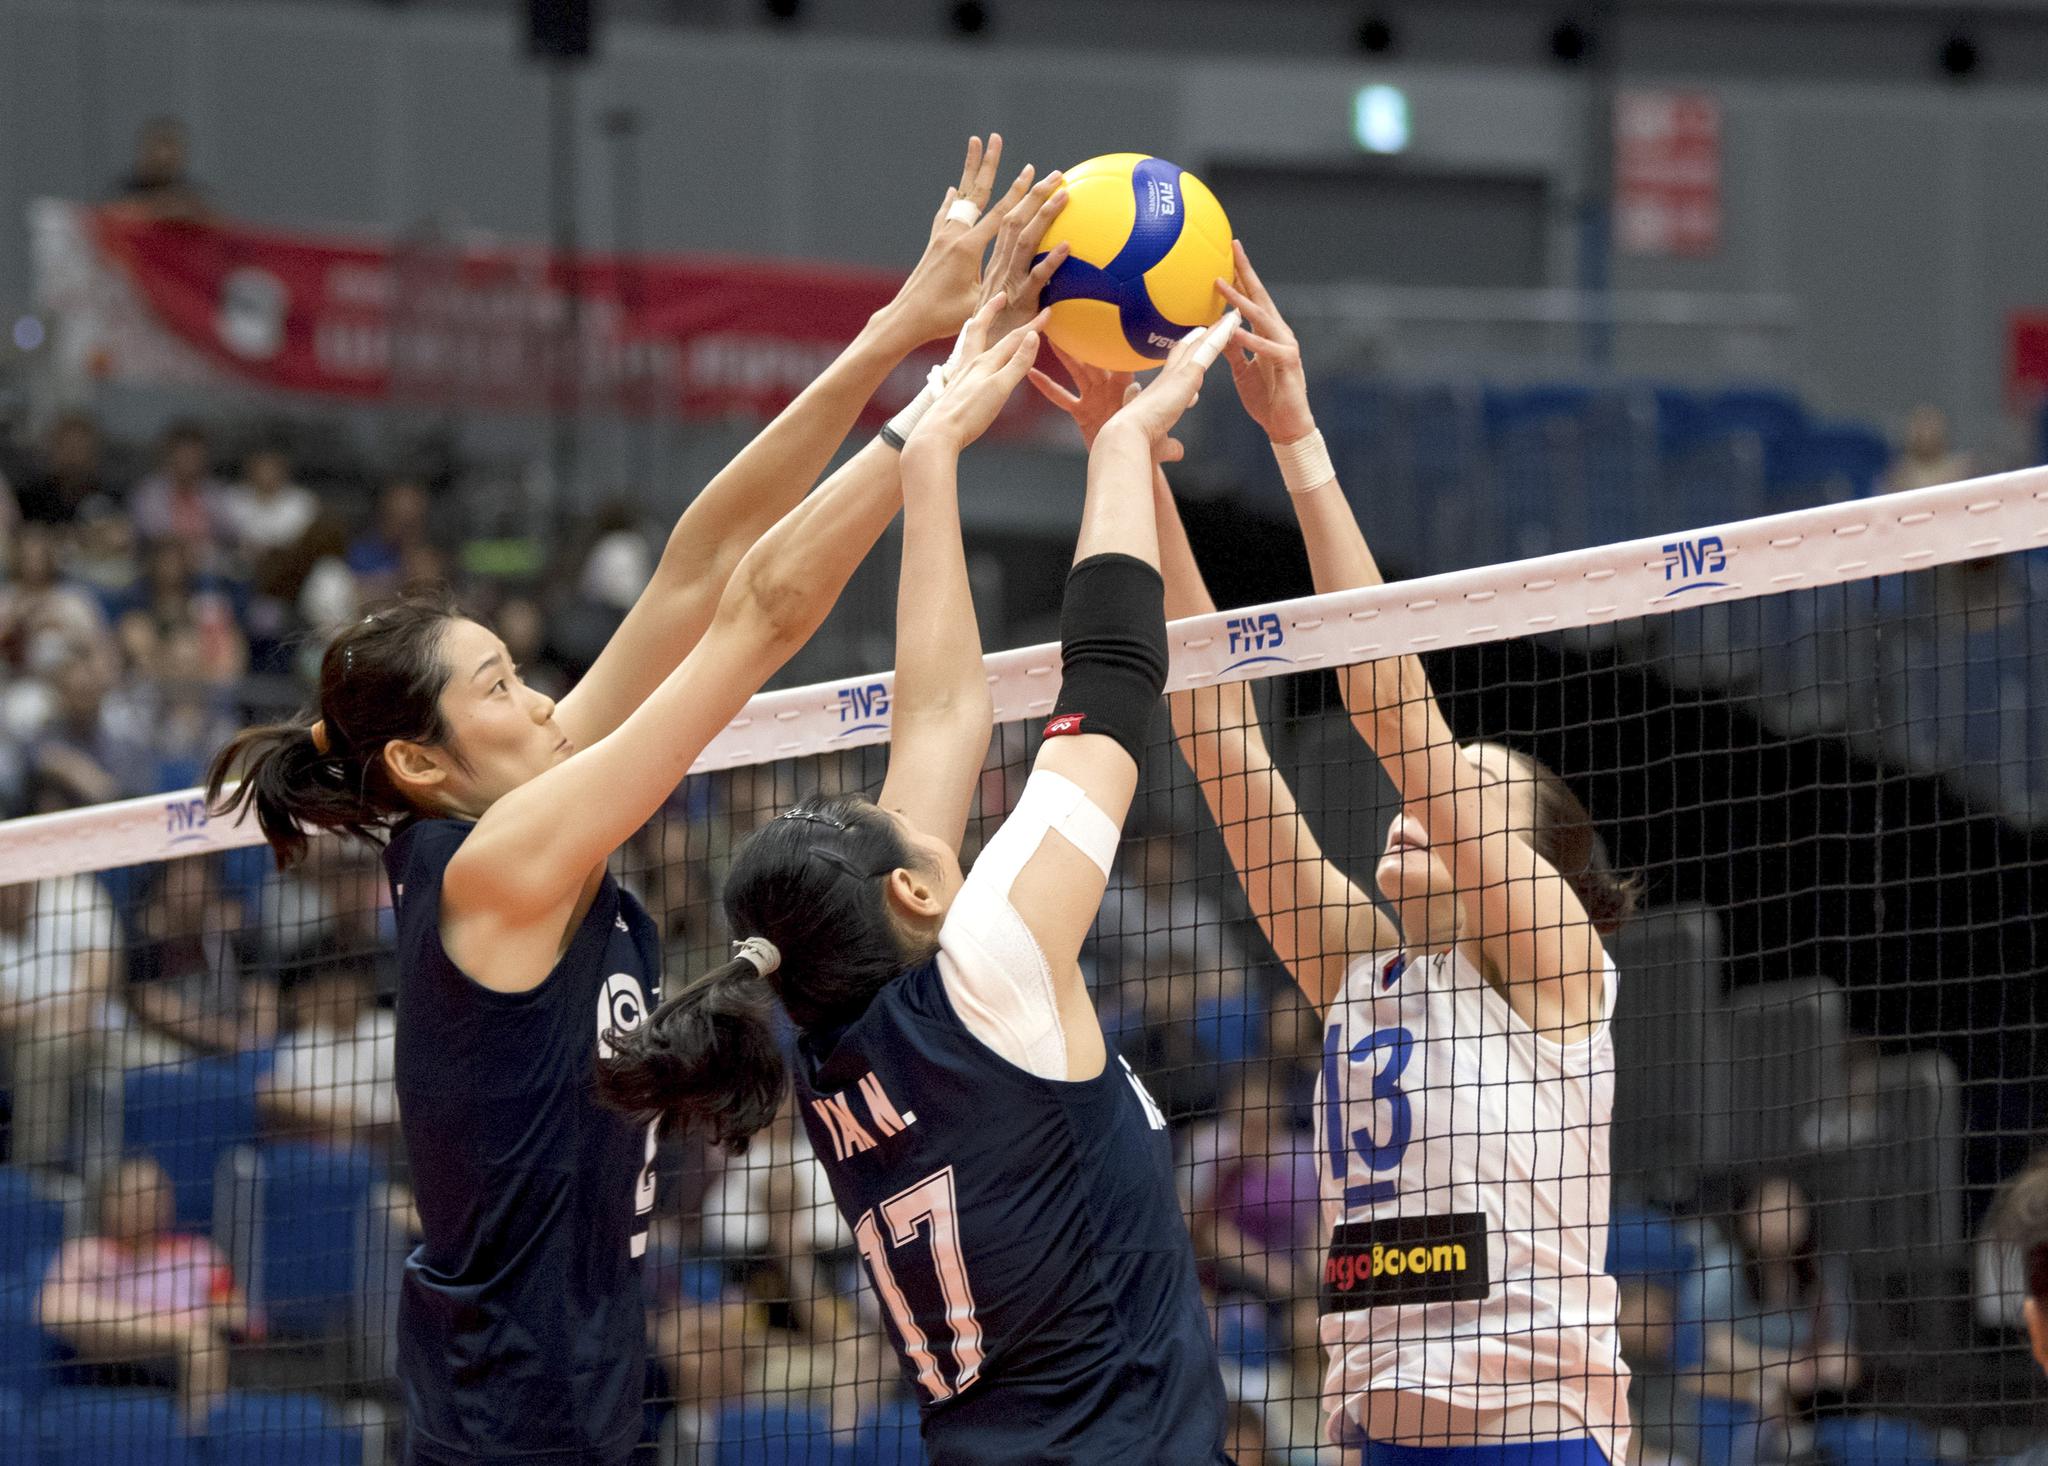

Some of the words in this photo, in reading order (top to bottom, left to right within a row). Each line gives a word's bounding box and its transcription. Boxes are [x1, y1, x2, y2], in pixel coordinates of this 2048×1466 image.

[1159, 181, 1176, 216] FIVB
[1147, 331, 1178, 349] ASA
[1662, 536, 1727, 581] FIVB
[1226, 613, 1284, 655] FIVB
[838, 683, 889, 722] FIVB
[1324, 1023, 1414, 1180] 13
[854, 1164, 986, 1405] 17
[1324, 1242, 1467, 1291] ngoBoom
